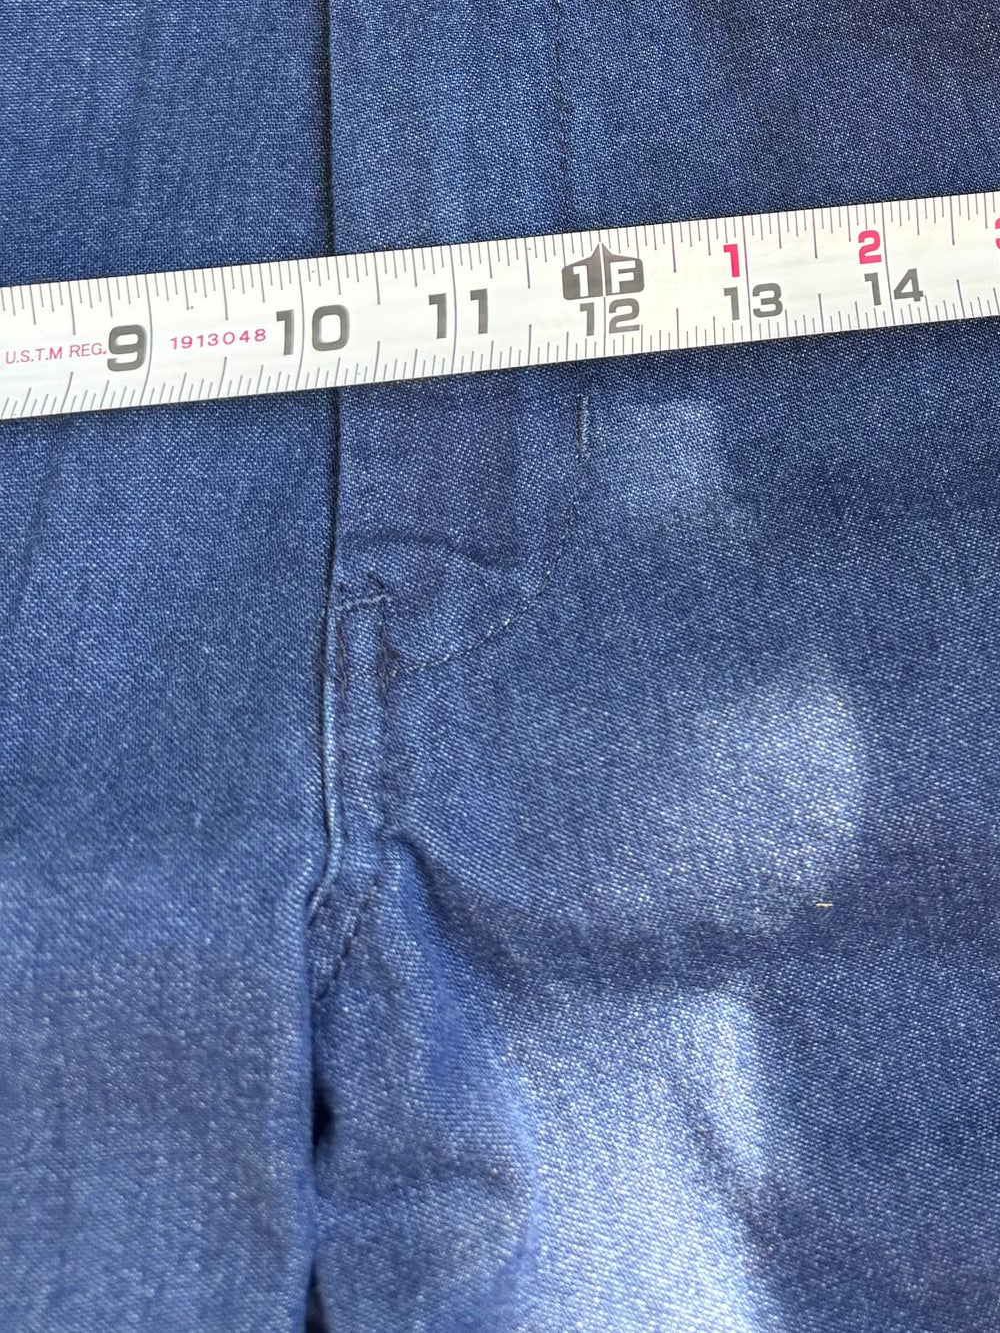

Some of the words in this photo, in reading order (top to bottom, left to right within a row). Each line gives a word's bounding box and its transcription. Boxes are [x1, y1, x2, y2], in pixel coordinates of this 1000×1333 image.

[723, 244, 741, 278] 1
[858, 229, 882, 264] 2
[572, 259, 637, 297] 1F
[107, 324, 147, 372] 9
[276, 304, 350, 356] 10
[428, 288, 489, 339] 11
[580, 298, 640, 336] 12
[723, 282, 783, 321] 13
[864, 268, 924, 306] 14
[170, 328, 267, 350] 1913048
[5, 347, 63, 365] U.S.T.M
[68, 341, 108, 358] REG.
